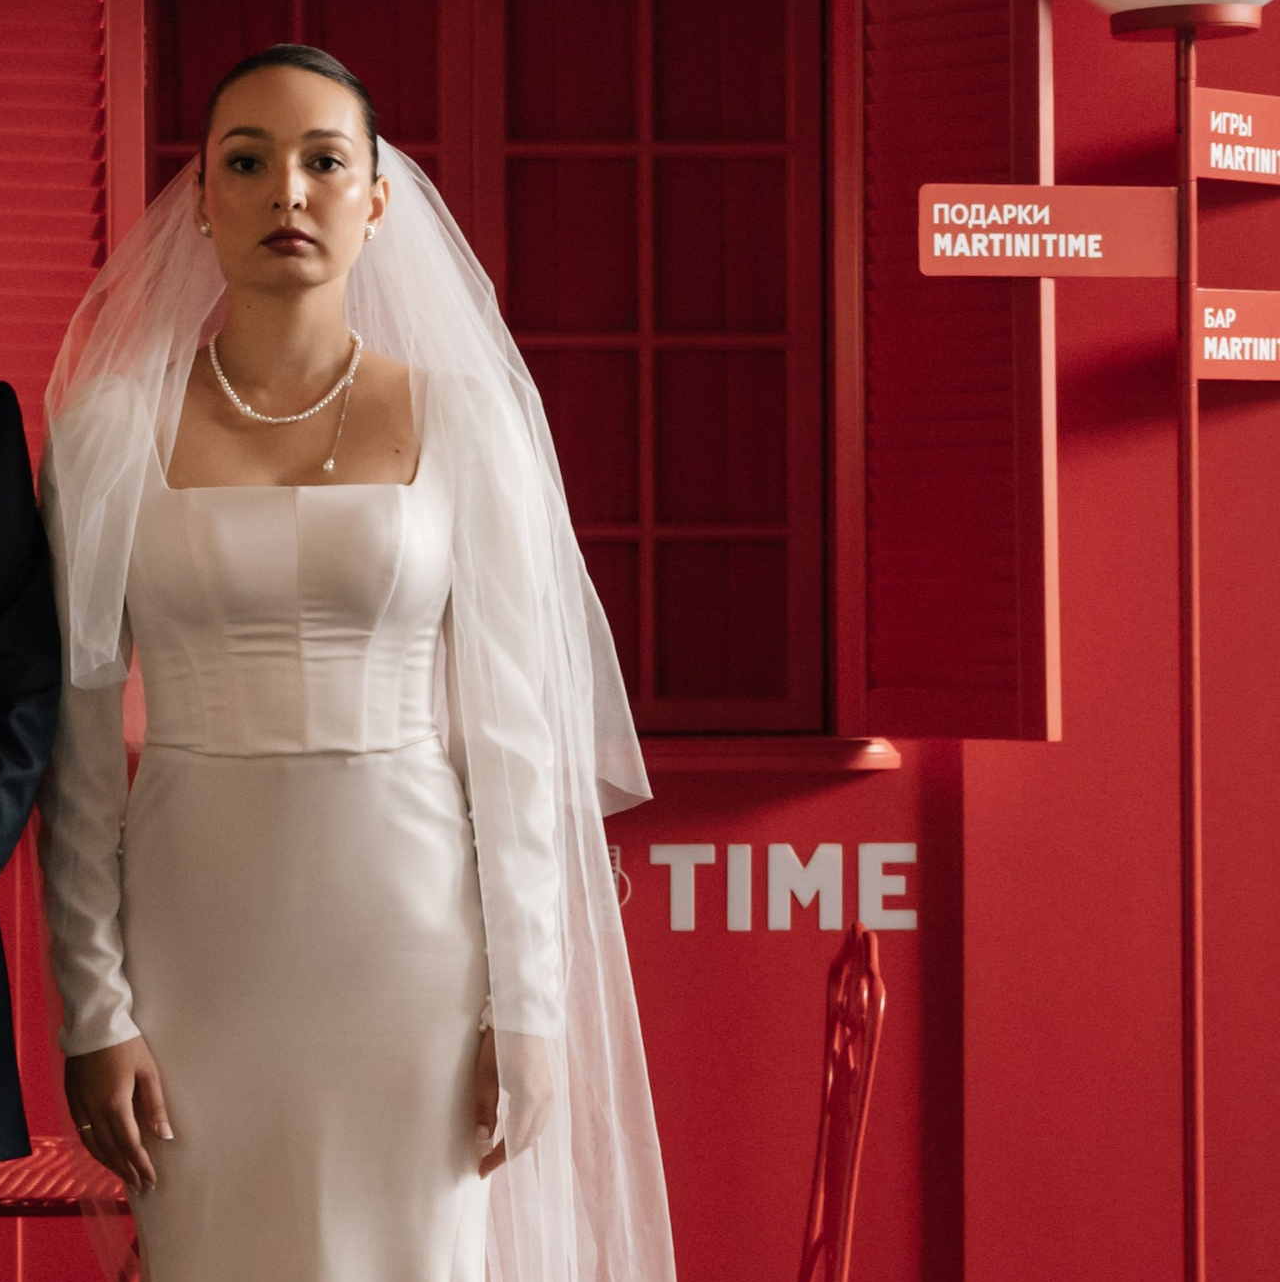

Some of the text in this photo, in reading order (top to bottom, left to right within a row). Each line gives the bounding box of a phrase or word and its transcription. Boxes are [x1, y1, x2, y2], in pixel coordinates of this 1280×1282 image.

[1211, 110, 1252, 138] ИГРЫ
[932, 203, 1051, 229] ПОДАРКИ
[1204, 307, 1237, 329] БАР
[649, 842, 918, 932] TIME
